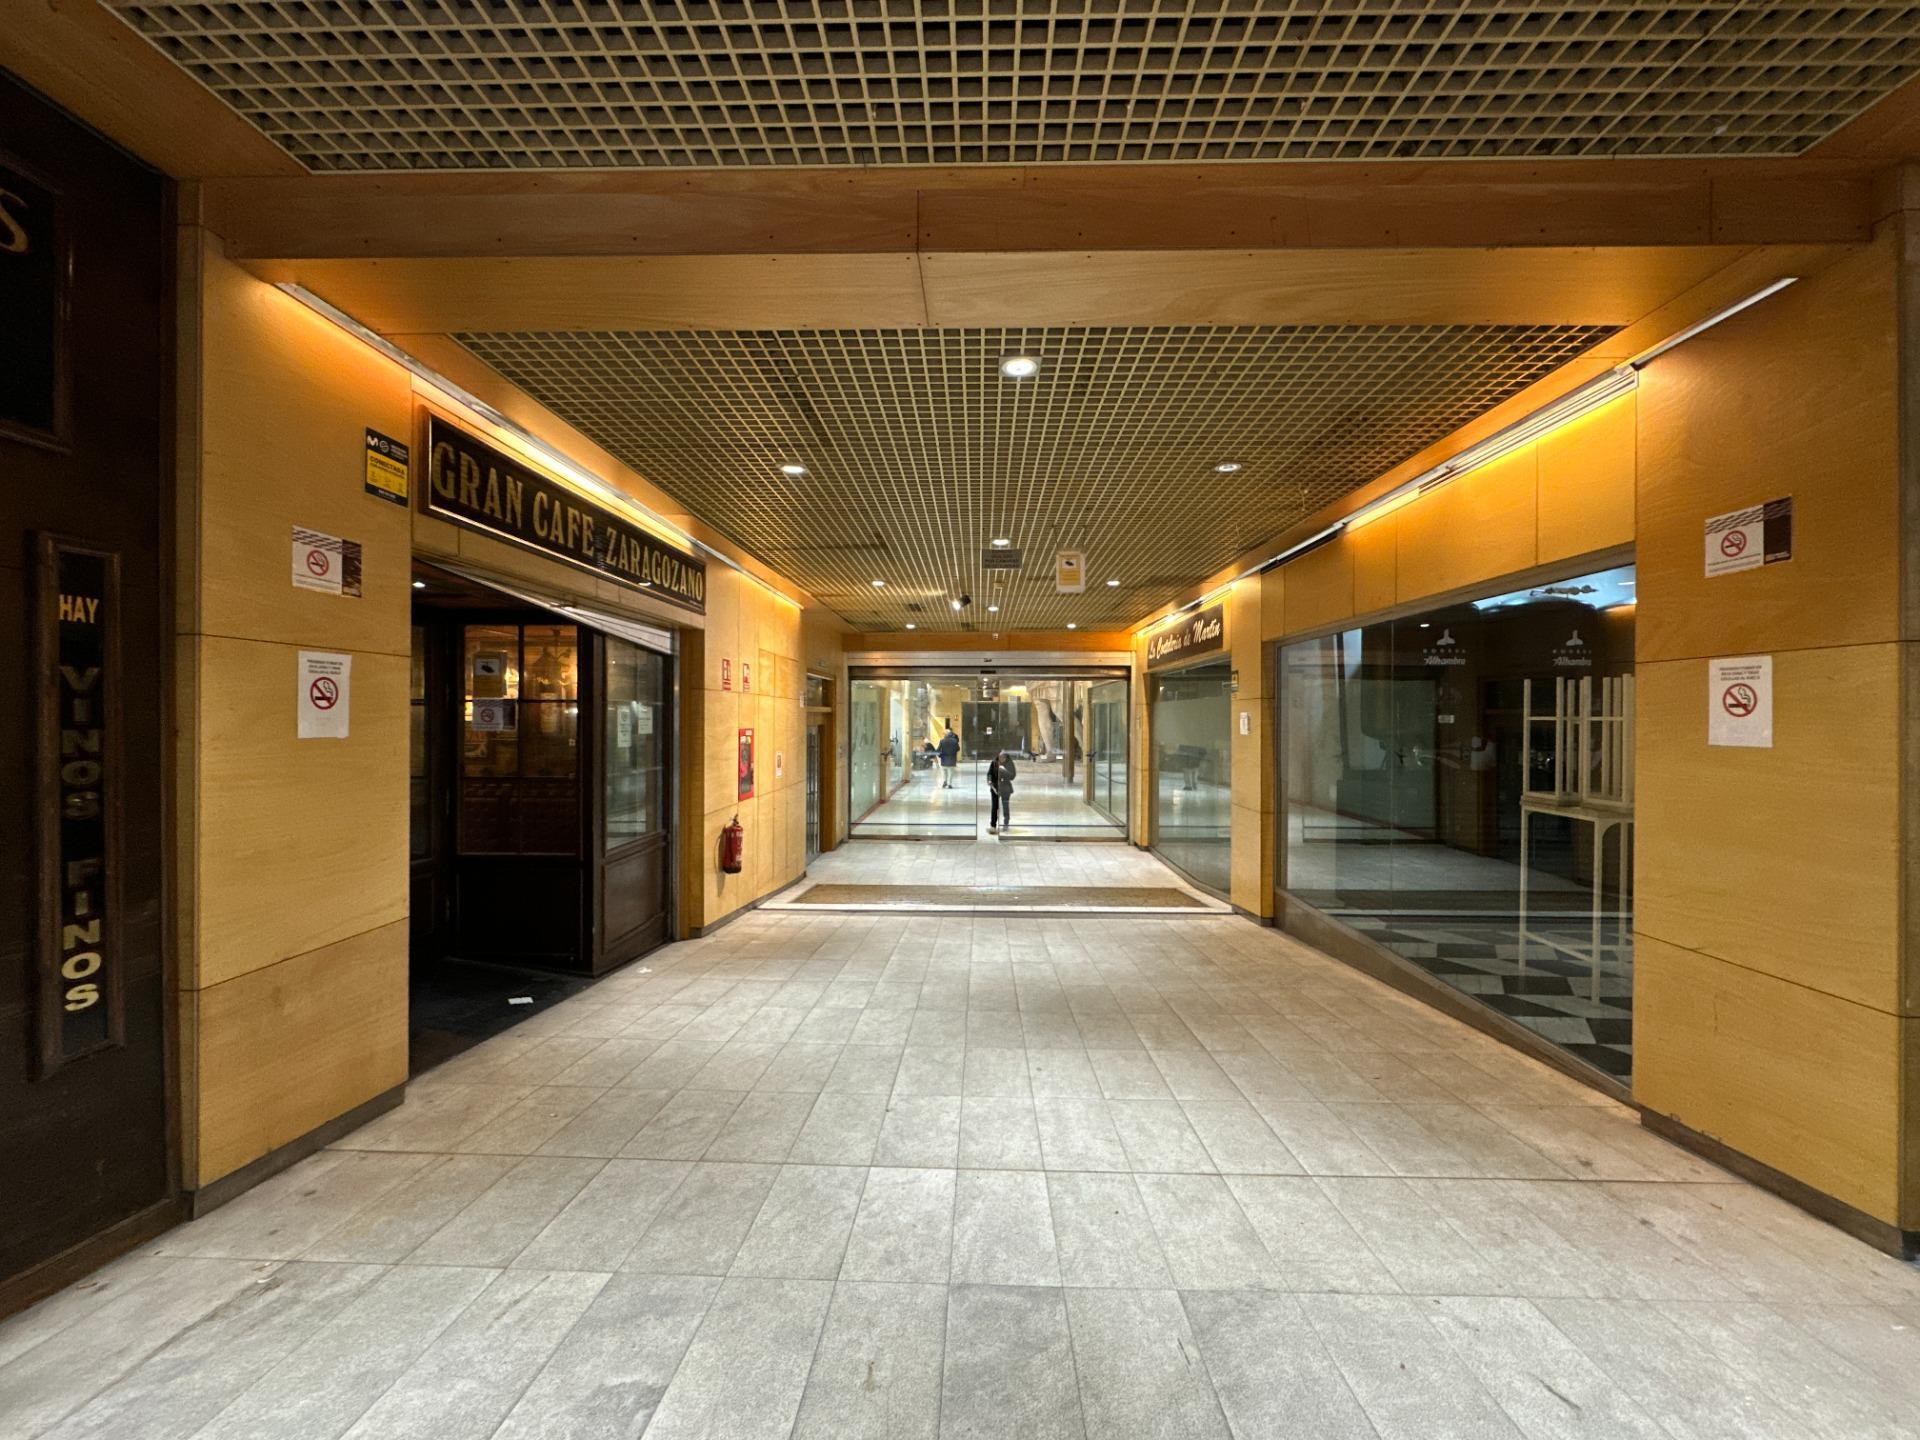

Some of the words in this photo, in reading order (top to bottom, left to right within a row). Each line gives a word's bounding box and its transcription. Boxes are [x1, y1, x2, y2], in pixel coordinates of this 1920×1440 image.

[431, 441, 523, 530] GRAN
[532, 490, 595, 555] CAFE
[605, 526, 704, 601] ZARAGOZANO
[59, 594, 99, 624] HAY
[59, 665, 102, 820] VINOS
[61, 857, 102, 1012] FINOS
